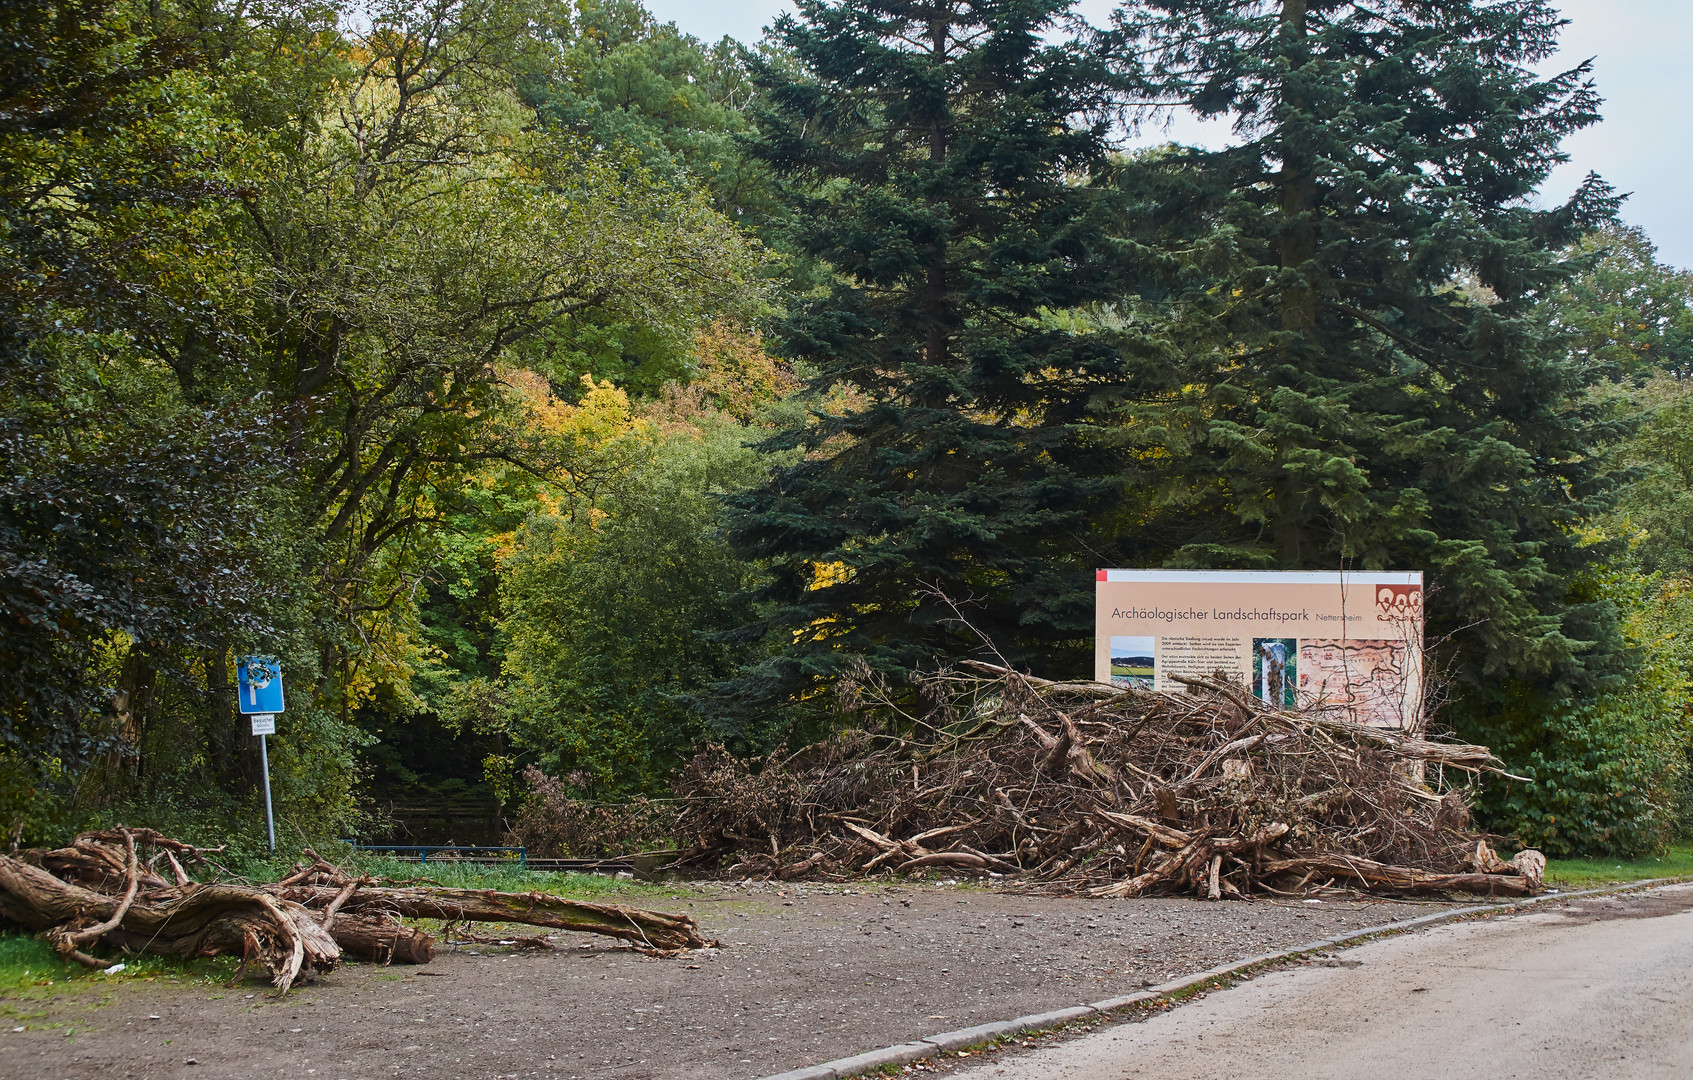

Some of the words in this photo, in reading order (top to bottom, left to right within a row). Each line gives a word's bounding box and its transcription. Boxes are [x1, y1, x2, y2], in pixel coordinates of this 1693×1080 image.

[1112, 606, 1208, 622] Archäologischer
[1213, 607, 1309, 623] Landschaftspark
[1316, 613, 1362, 622] Nettersheim
[248, 663, 270, 706] P
